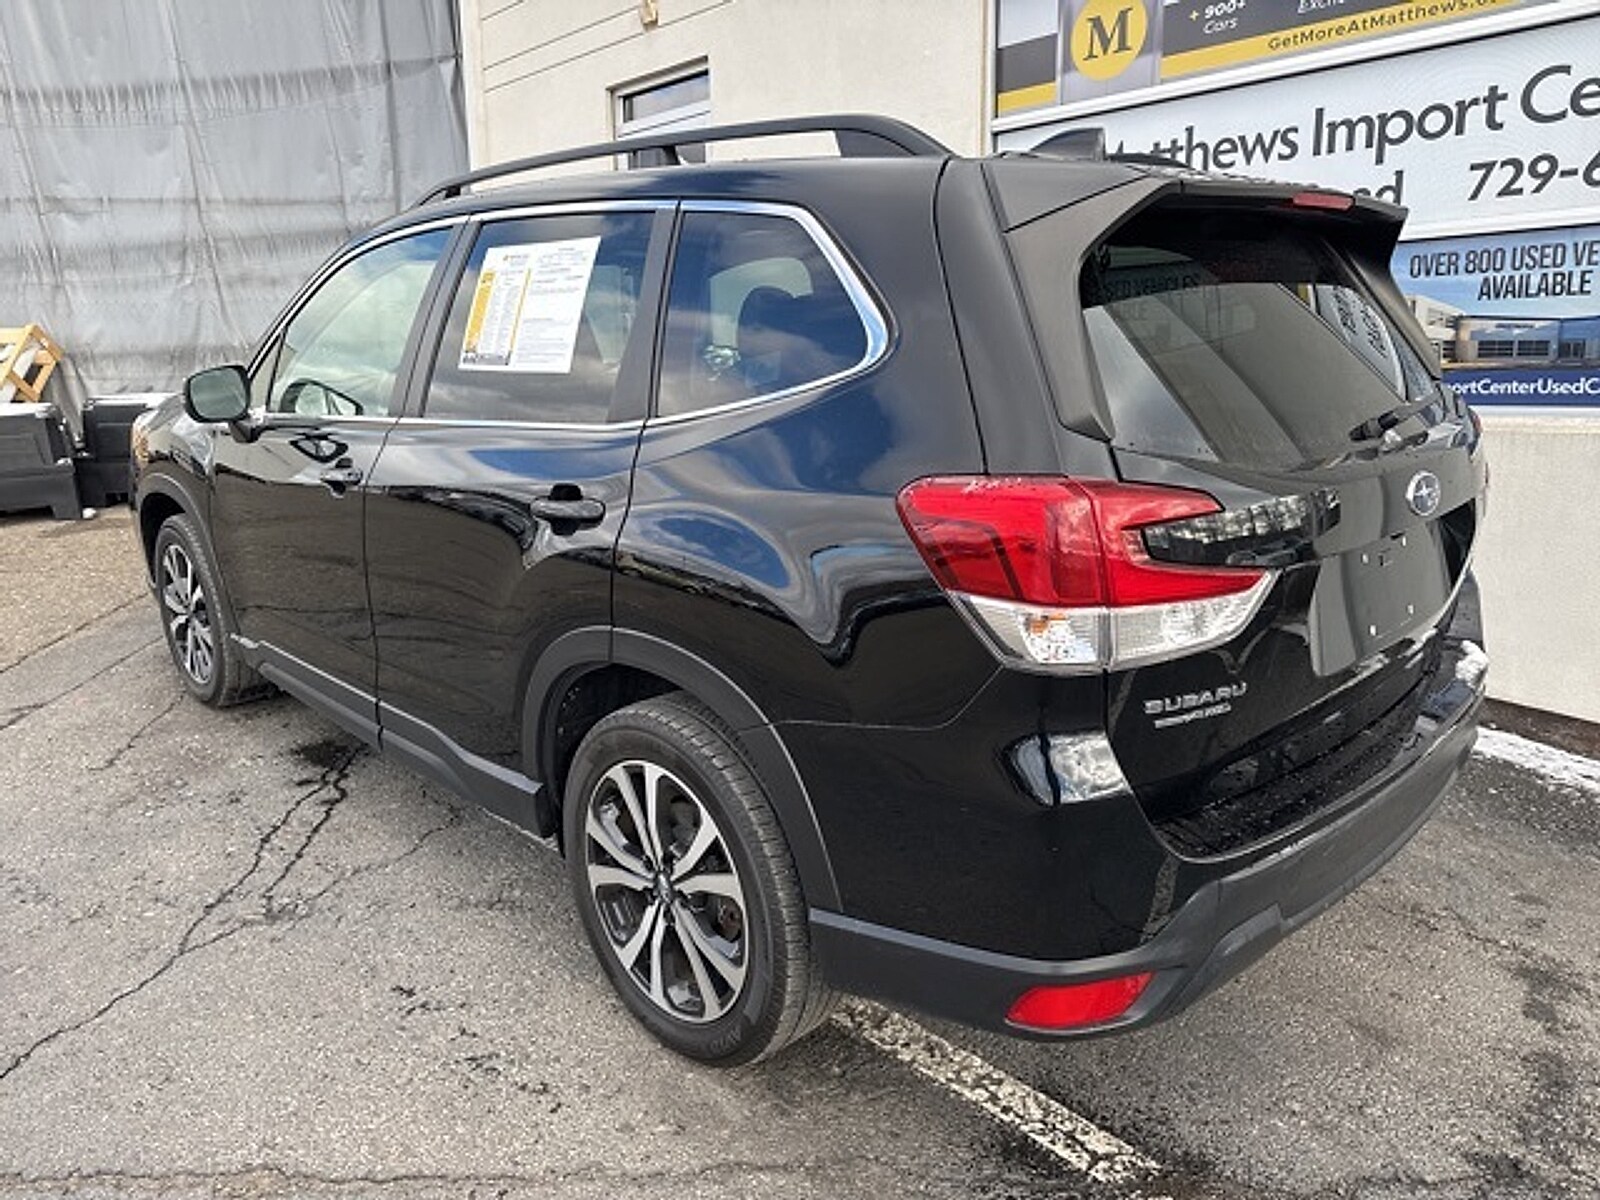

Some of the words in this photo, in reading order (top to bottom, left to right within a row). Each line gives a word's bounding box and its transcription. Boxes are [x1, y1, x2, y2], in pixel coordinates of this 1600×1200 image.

[1083, 7, 1133, 61] M
[1203, 17, 1239, 34] Cars
[1312, 84, 1509, 166] Import
[1409, 252, 1459, 279] OVER
[1464, 247, 1506, 274] 800
[1512, 242, 1567, 271] USED
[1477, 269, 1594, 301] AVAILABLE
[1446, 377, 1600, 395] ortCenterUsedC
[1143, 680, 1248, 715] SUBARU
